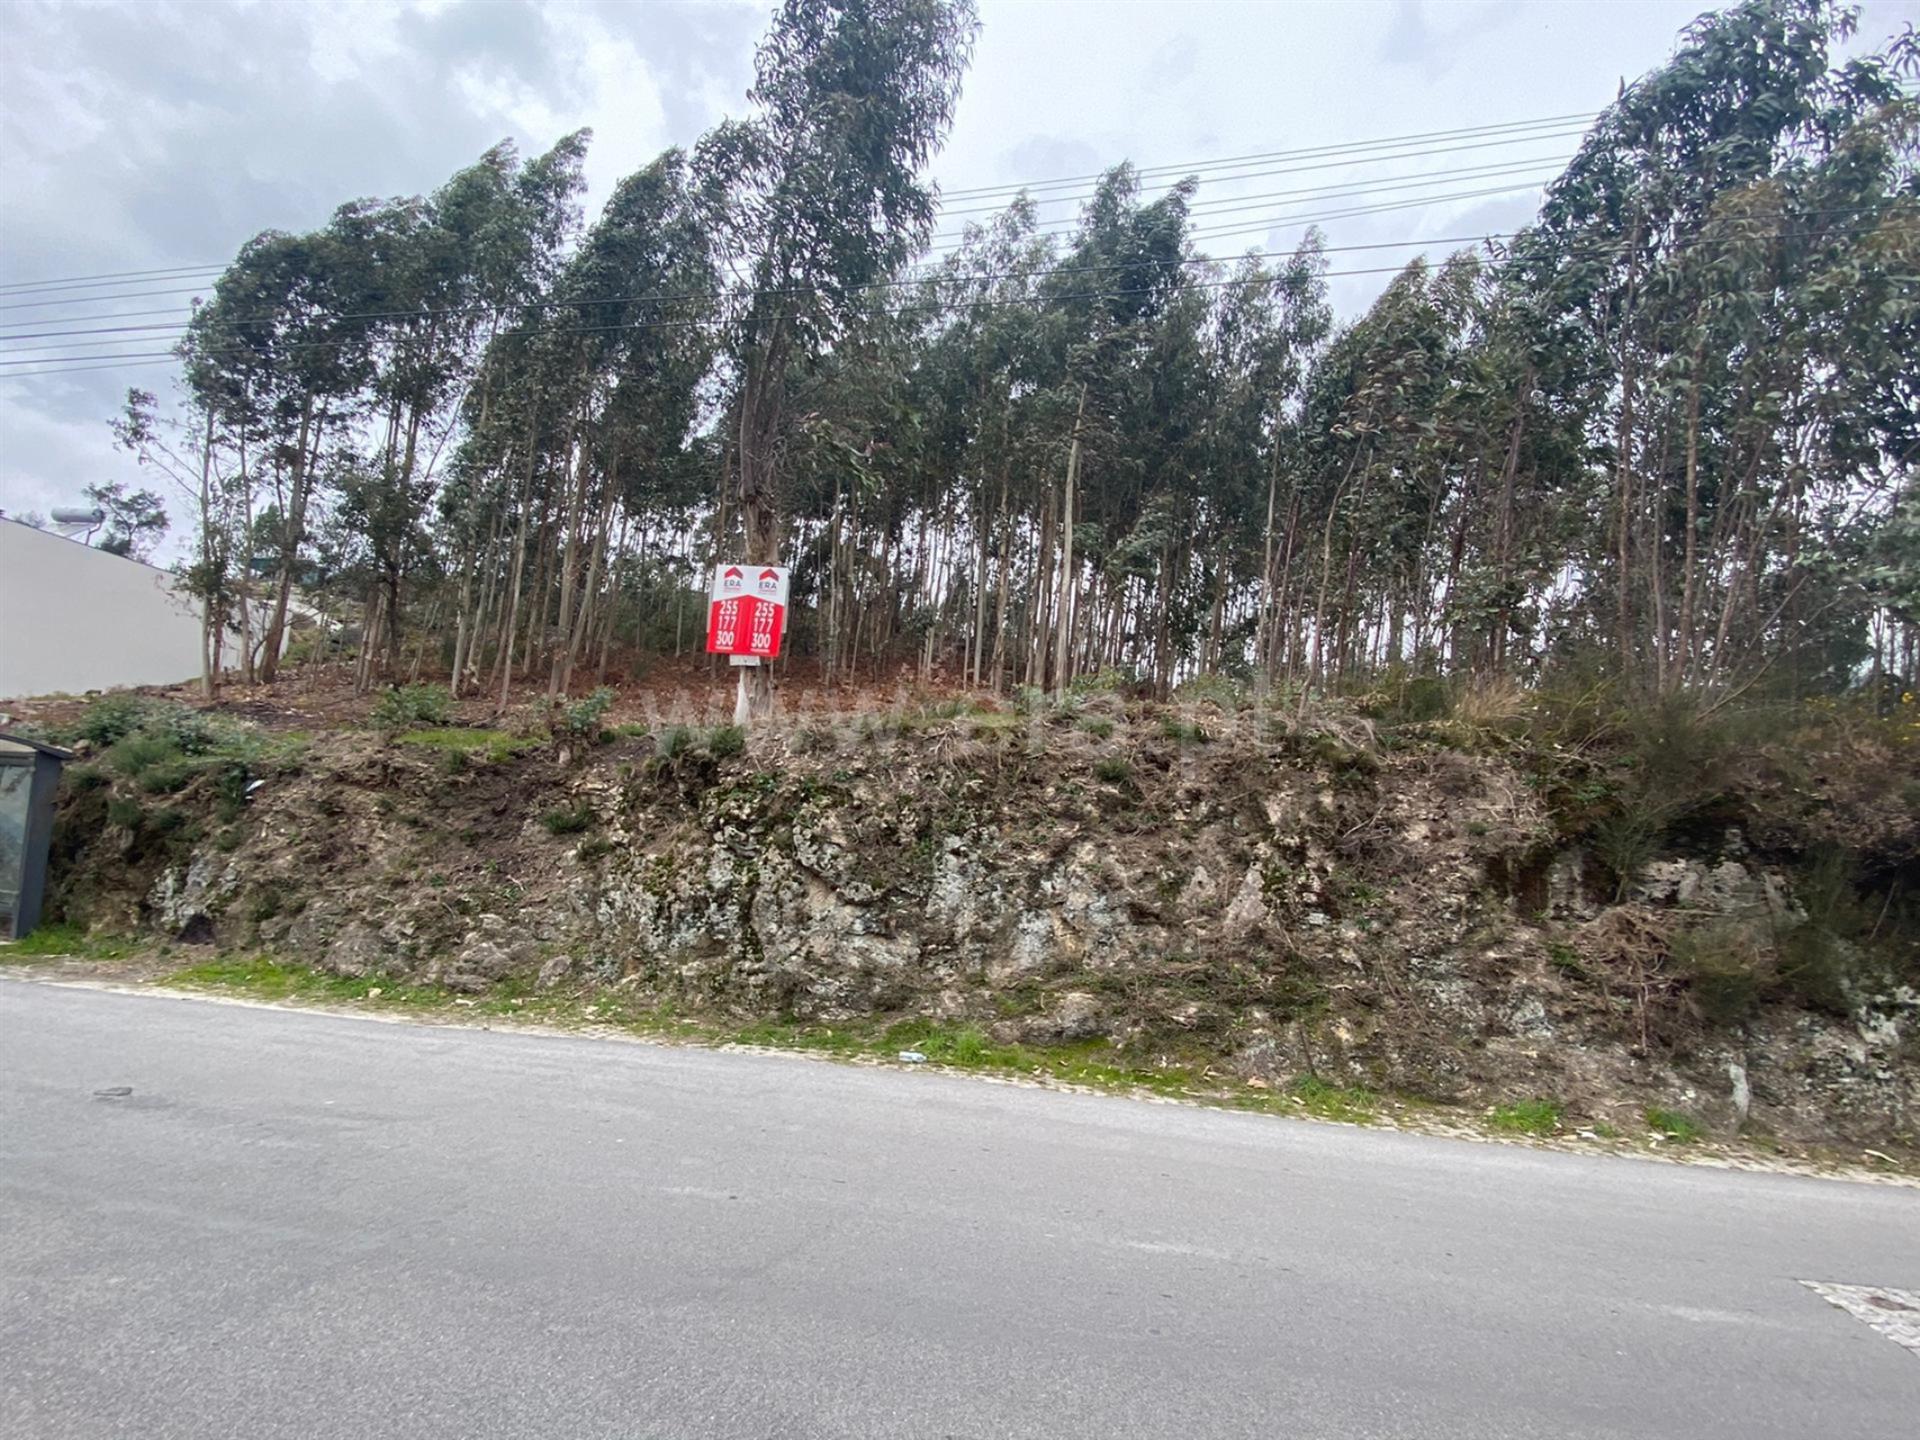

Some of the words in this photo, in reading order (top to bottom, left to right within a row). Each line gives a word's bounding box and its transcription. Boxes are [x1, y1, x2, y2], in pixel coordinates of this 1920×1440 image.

[724, 579, 741, 587] ERA
[720, 600, 738, 615] 255
[755, 602, 774, 617] 255
[719, 616, 737, 630] 177
[754, 618, 773, 632] 177
[716, 631, 735, 646] 300
[752, 633, 771, 648] 300
